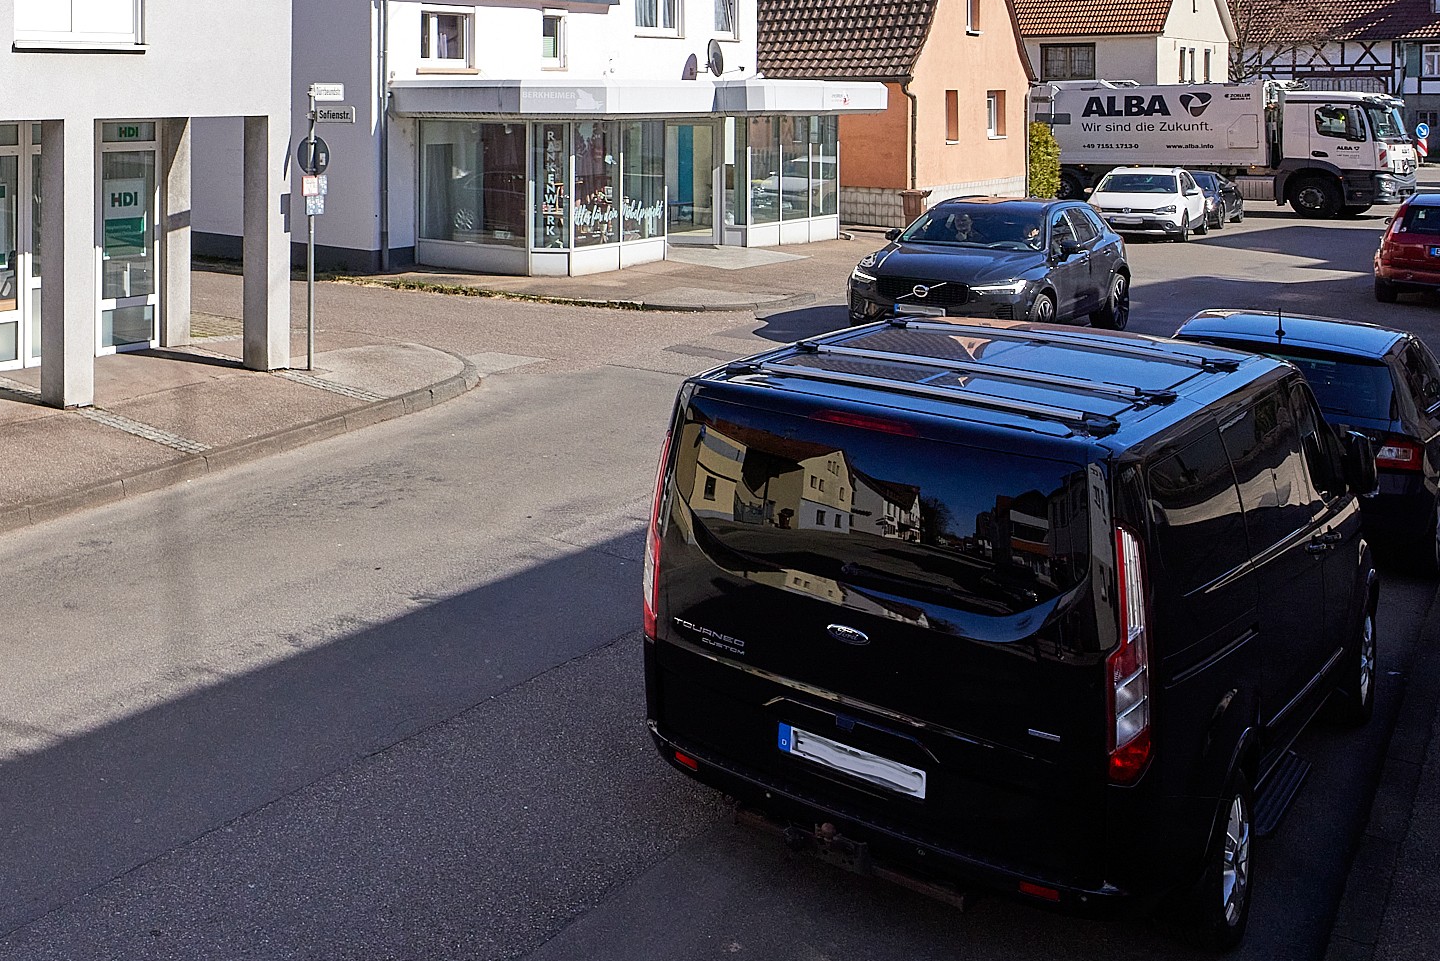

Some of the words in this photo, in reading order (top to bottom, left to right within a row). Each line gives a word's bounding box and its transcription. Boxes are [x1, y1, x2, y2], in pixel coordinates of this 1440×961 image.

[522, 91, 576, 100] BERKHEIMER
[1081, 95, 1171, 117] ALBA
[318, 110, 351, 120] Sofienstr.
[119, 126, 139, 138] HDI
[1081, 122, 1102, 132] Wir
[1105, 122, 1131, 132] sind
[1135, 122, 1155, 132] die
[1159, 121, 1213, 132] Zukunft.
[111, 192, 138, 207] HDI
[674, 617, 745, 647] TOURNEO
[702, 637, 745, 655] CUSTOM
